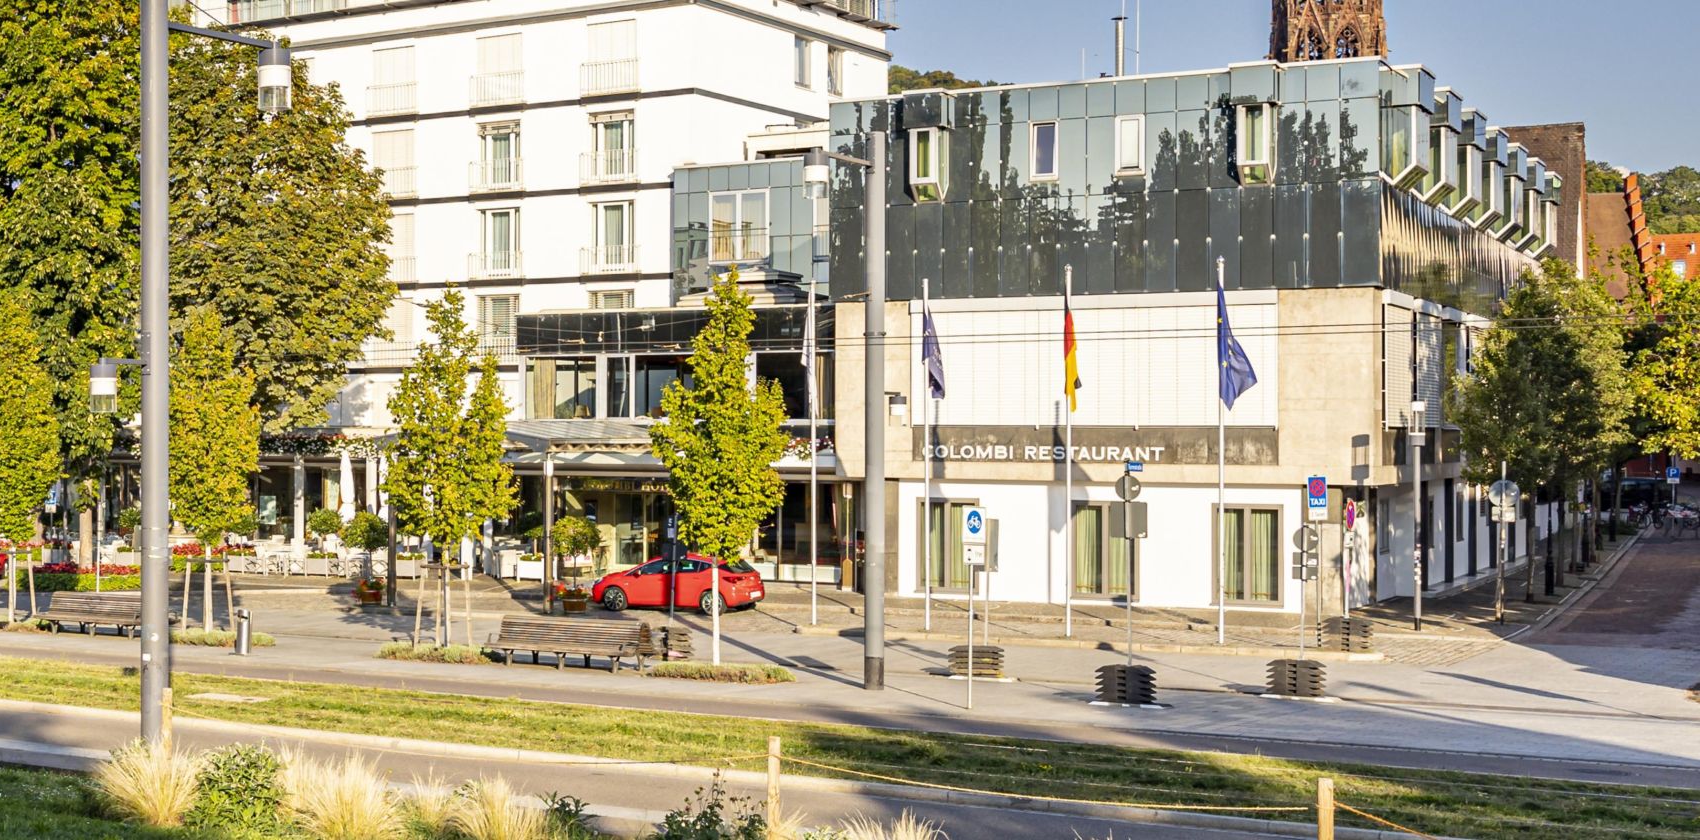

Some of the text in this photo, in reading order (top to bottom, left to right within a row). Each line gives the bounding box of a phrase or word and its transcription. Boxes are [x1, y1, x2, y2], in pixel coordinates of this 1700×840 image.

[922, 445, 1165, 462] COLOMBI RESTAURANT
[1670, 468, 1677, 476] P
[1310, 497, 1326, 506] TAXI
